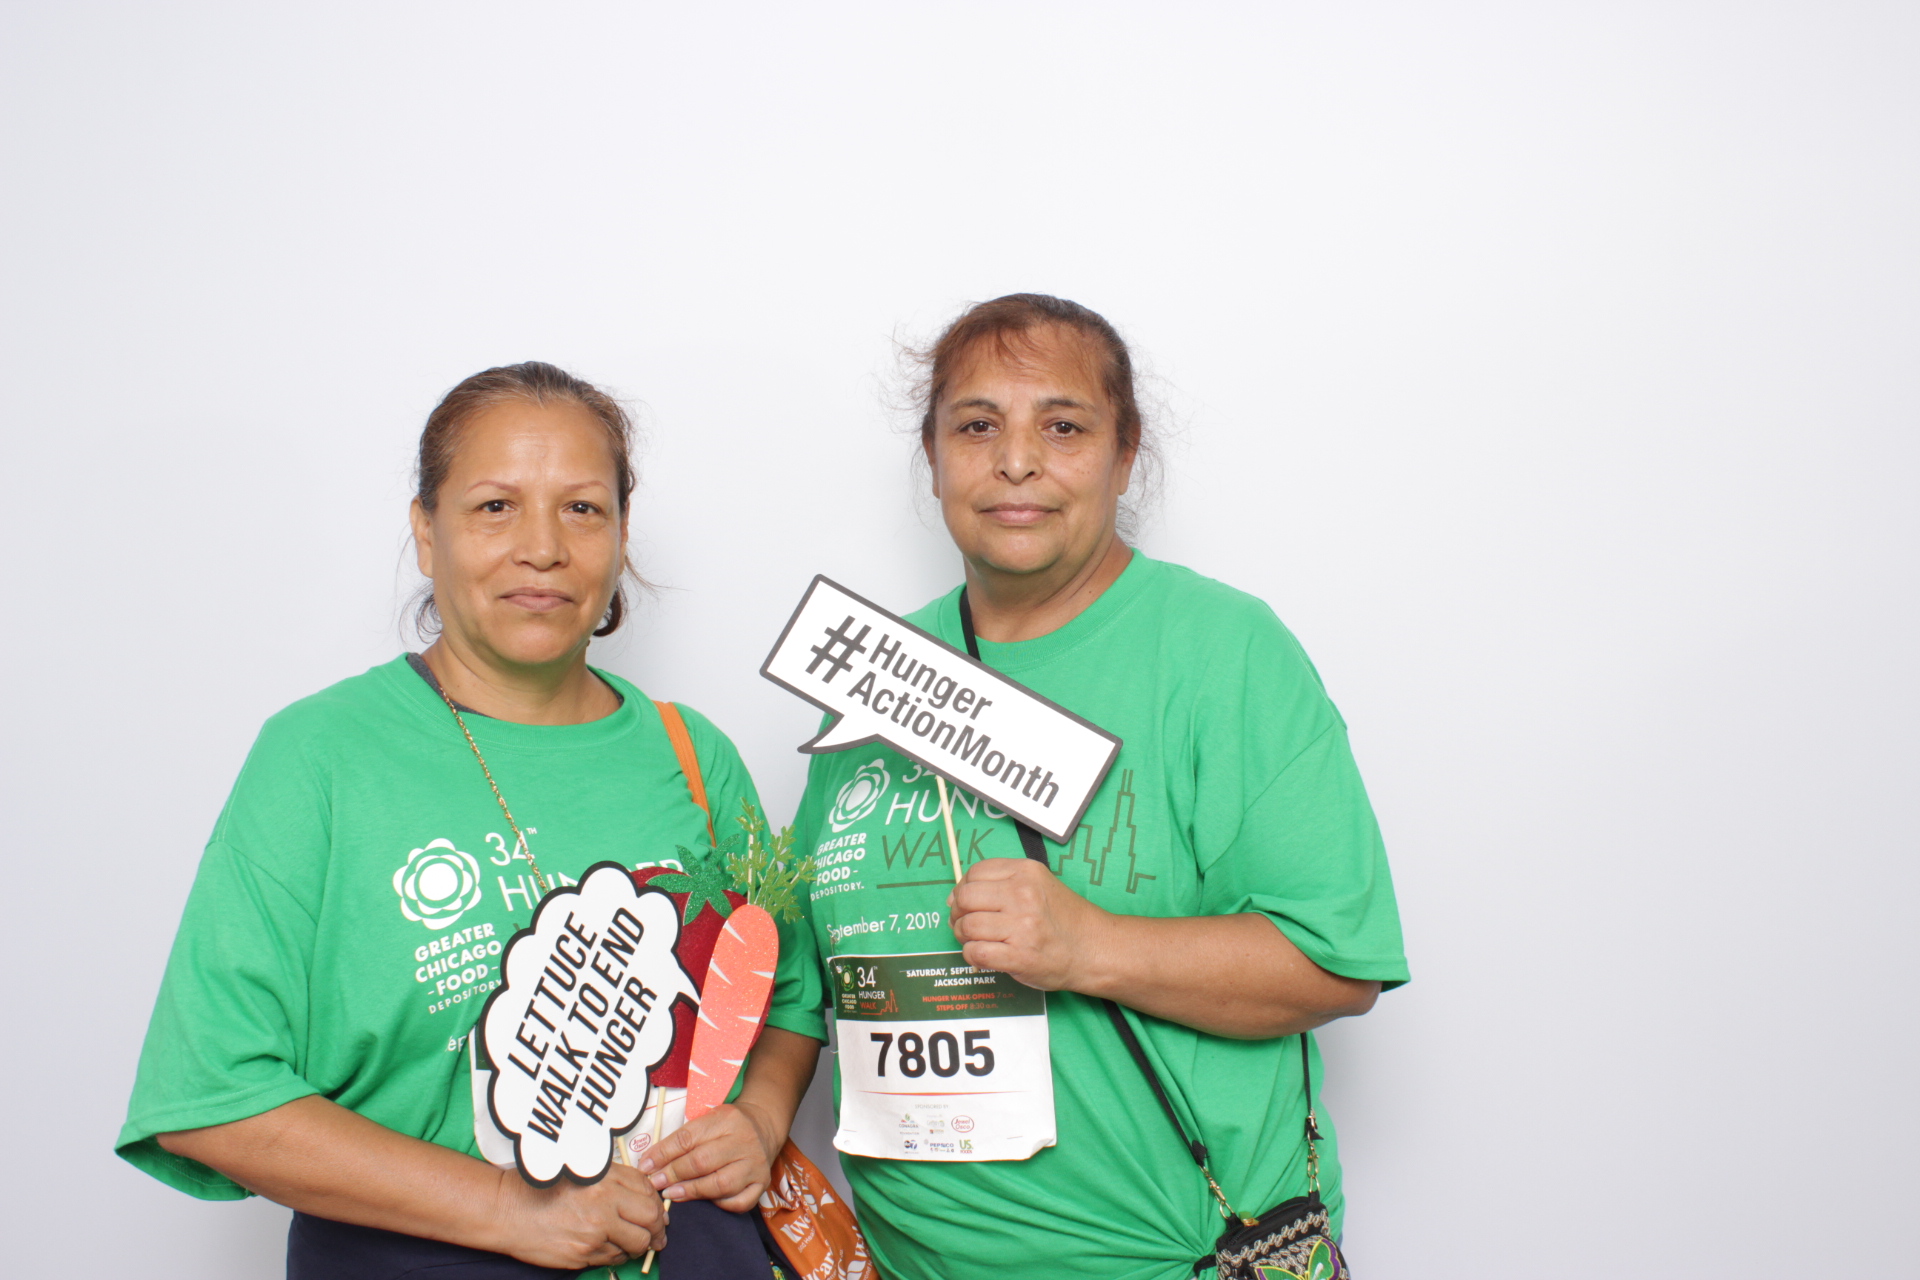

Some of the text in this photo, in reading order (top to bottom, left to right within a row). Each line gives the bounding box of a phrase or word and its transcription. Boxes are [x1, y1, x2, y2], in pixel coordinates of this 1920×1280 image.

[847, 672, 1060, 807] ActionMonth
[816, 833, 867, 856] GREATER
[889, 914, 901, 934] 7,
[906, 911, 941, 930] 2019
[414, 923, 495, 962] GREATER
[414, 941, 502, 983] CHICAGO
[906, 968, 948, 978] SATURDAY,
[508, 912, 597, 1080] LETTUCE
[858, 991, 885, 1000] HUNGER
[934, 976, 996, 987] JACKSON PARK
[860, 1002, 877, 1010] WALK
[922, 995, 949, 1003] HUNGER
[972, 992, 995, 1000] OPENS
[527, 908, 644, 1143] WALK TO END
[576, 976, 657, 1125] HUNGER
[870, 1029, 995, 1078] 7805
